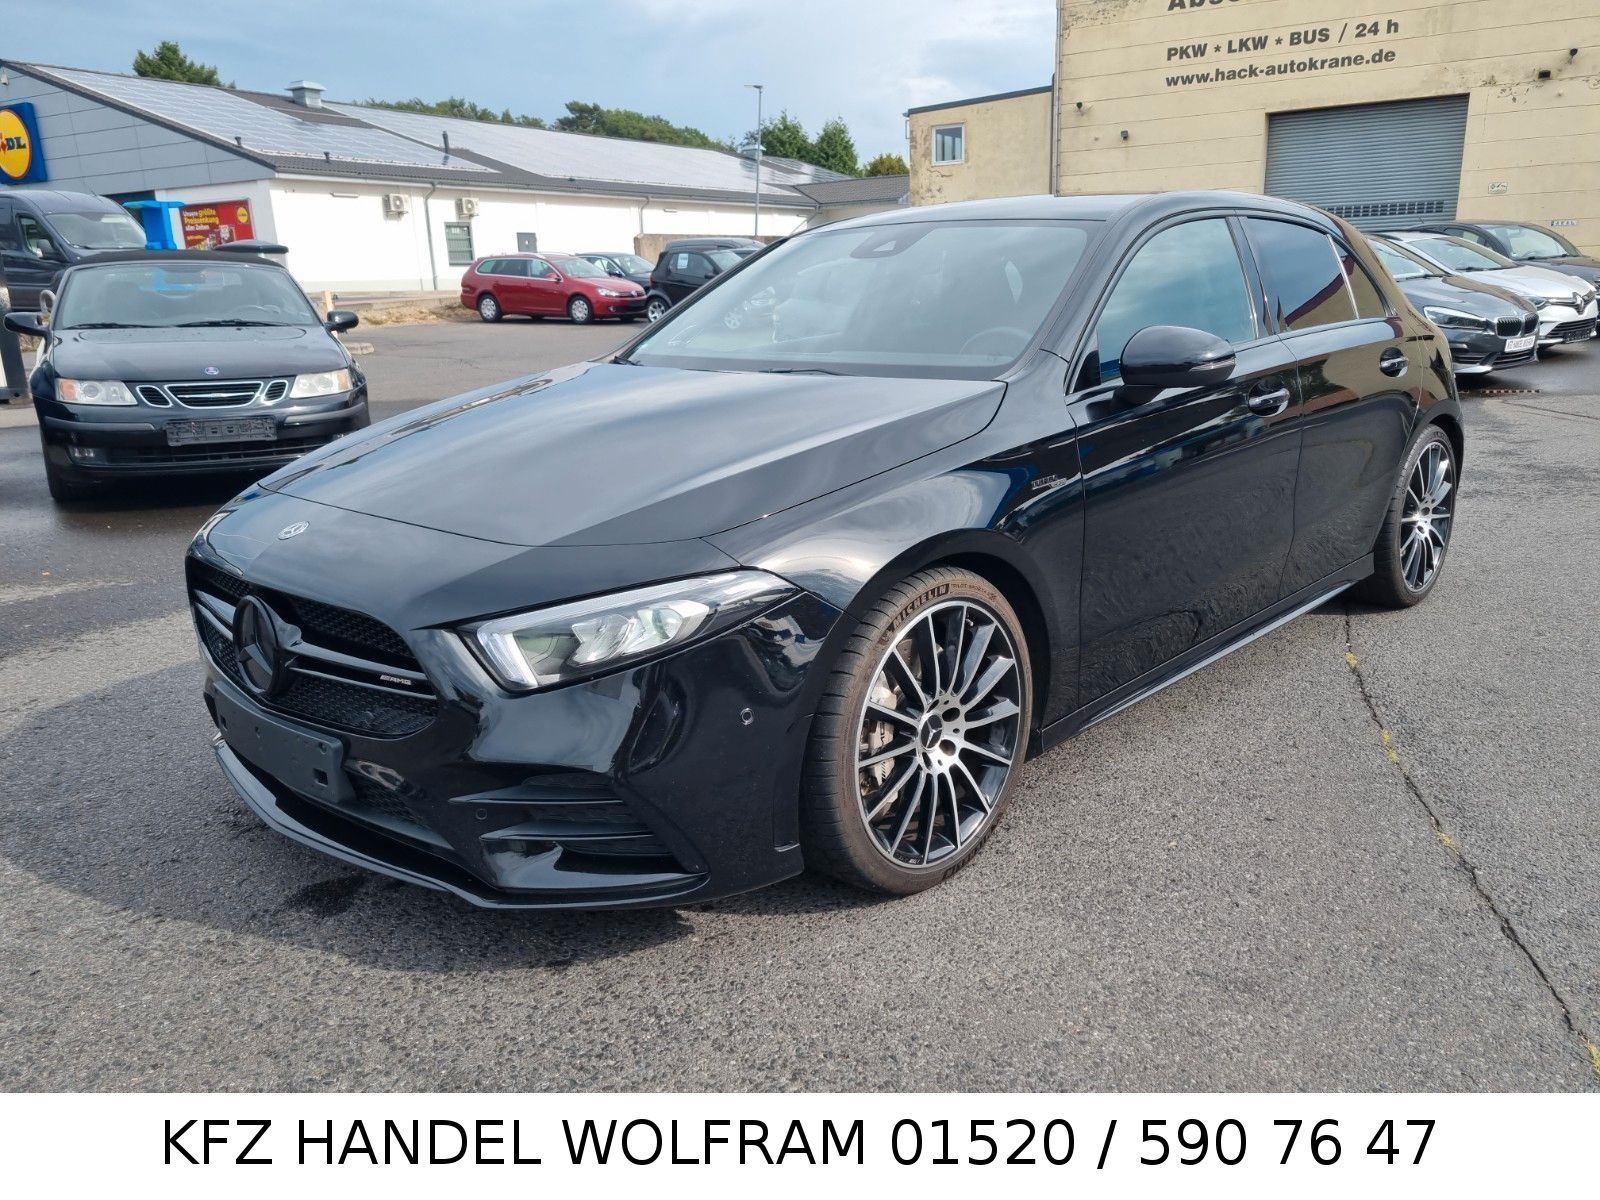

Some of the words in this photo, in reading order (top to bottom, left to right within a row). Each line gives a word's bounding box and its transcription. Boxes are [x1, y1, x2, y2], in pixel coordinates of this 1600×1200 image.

[1167, 43, 1208, 60] PKW
[1227, 35, 1268, 53] LKW
[1289, 28, 1330, 46] BUS
[1355, 21, 1379, 38] 24
[1386, 19, 1399, 34] h
[1166, 49, 1396, 87] www.hack-autokrane.de
[893, 585, 946, 627] MICHELIN
